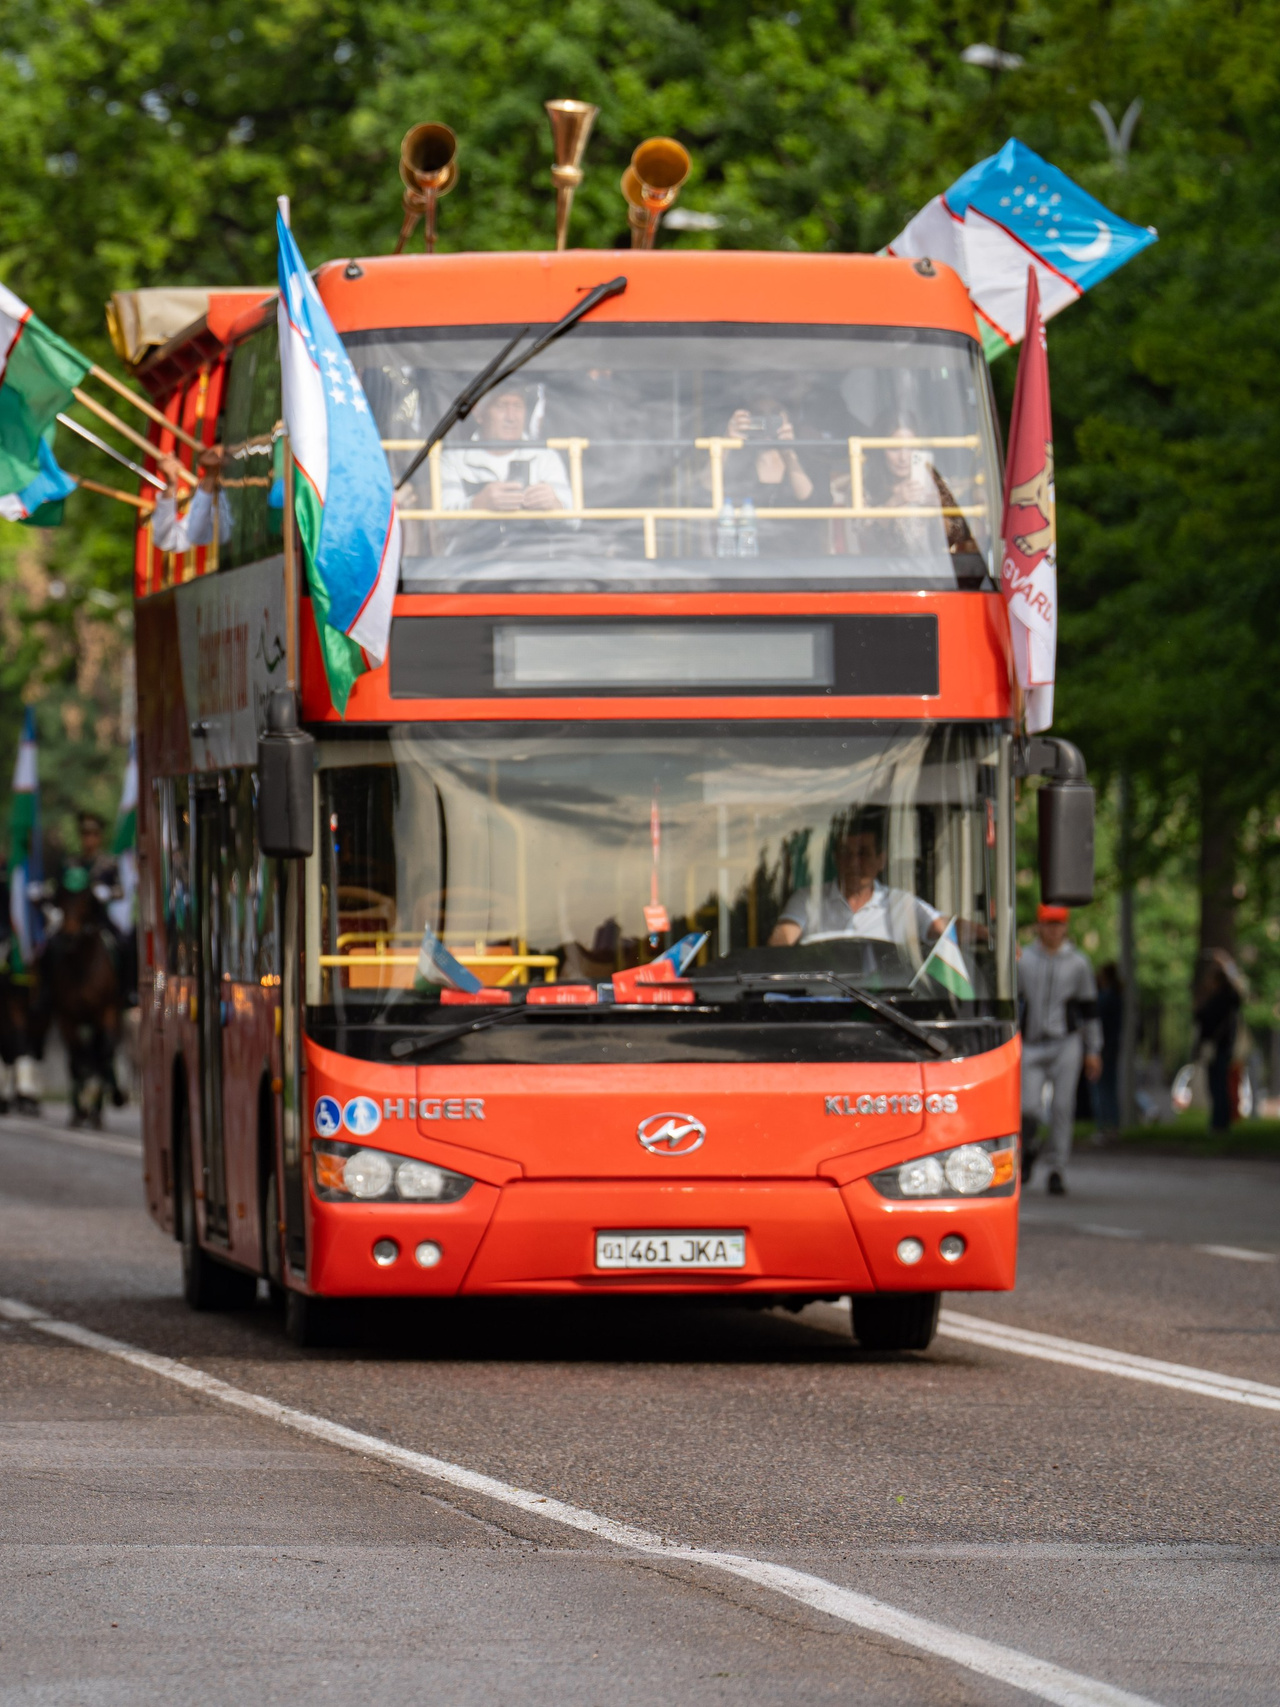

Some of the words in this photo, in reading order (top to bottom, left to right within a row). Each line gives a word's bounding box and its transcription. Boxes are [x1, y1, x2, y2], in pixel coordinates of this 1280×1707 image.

[382, 1097, 486, 1120] HIGER
[602, 1242, 624, 1260] 01
[629, 1240, 672, 1262] 461
[680, 1240, 728, 1262] JKA
